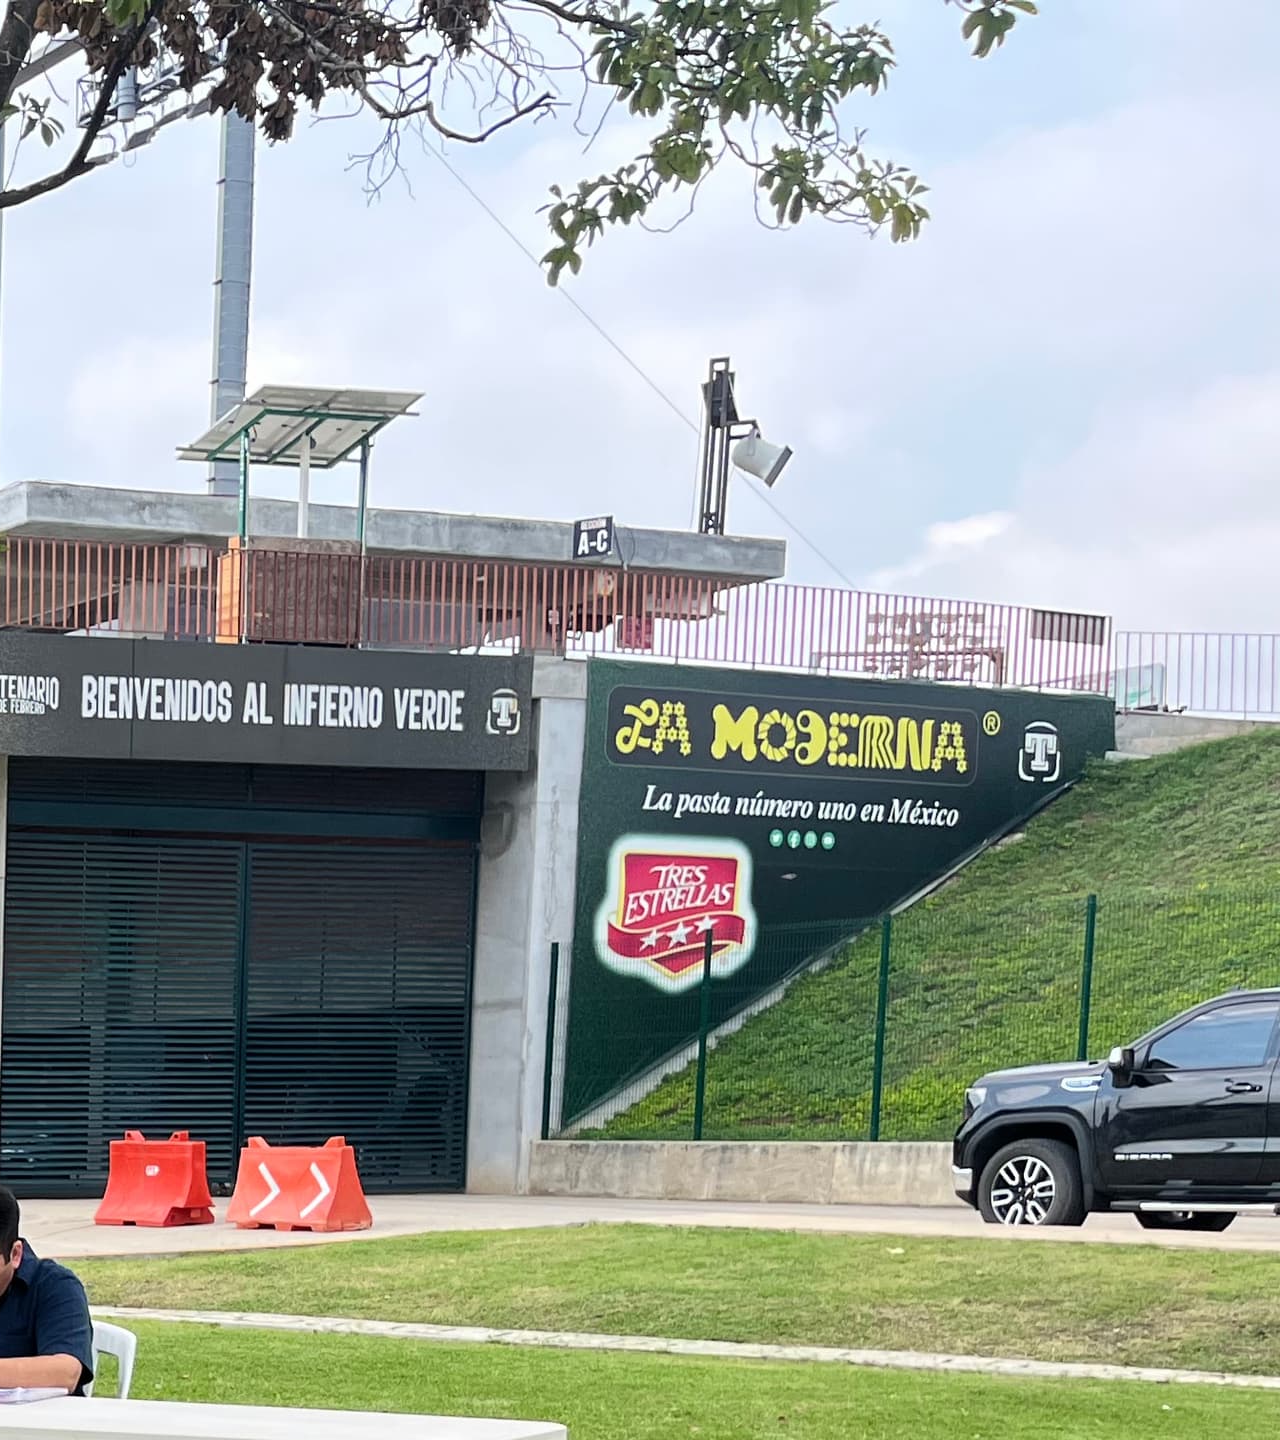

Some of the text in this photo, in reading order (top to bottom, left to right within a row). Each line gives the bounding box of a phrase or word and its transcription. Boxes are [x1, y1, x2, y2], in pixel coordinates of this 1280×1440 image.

[577, 529, 608, 555] A-C
[10, 699, 46, 714] FEBRERO
[81, 674, 465, 732] BIENVENIDOS AL INFIERNO VERDE
[615, 698, 692, 757] LA
[710, 703, 968, 774] MODERNA
[642, 785, 960, 828] La pasta número uno en México
[649, 861, 709, 888] TRES
[624, 883, 734, 926] ESTRELLAS
